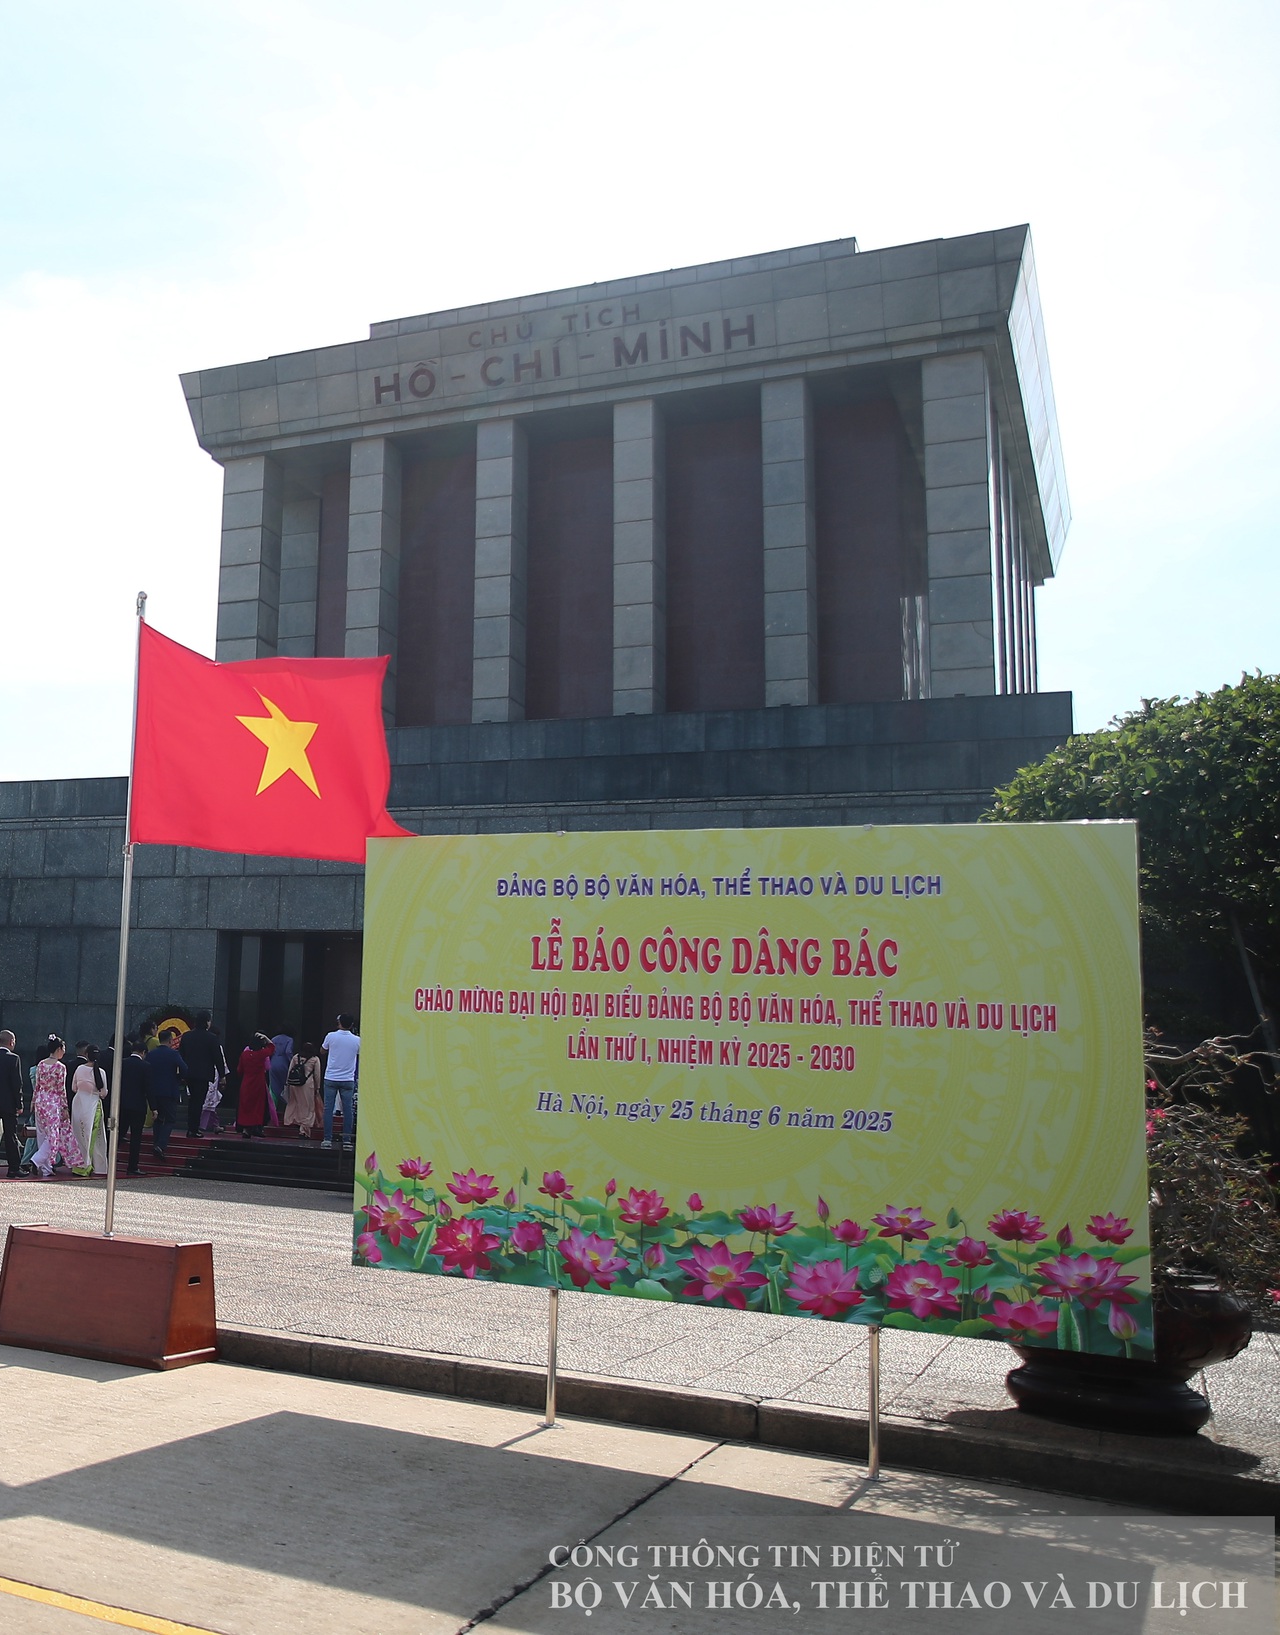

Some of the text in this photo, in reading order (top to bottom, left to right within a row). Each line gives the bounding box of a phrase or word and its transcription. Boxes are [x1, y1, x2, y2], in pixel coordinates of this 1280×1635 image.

[561, 304, 640, 337] TỊCH
[497, 867, 941, 900] ĐẢNG BỘ BỘ VĂN HÓA, THỂ THAO VÀ DU LỊCH
[530, 917, 898, 977] LỄ BÁO CÔNG DÂNG BÁC
[414, 984, 1057, 1037] CHÀO MỪNG ĐẠI HỘI ĐẠI BIỂU ĐẢNG BỘ BỘ VĂN HÓA, THỂ THAO VÀ DU LỊCH
[568, 1027, 599, 1060] LẦN
[604, 1031, 637, 1062] THỨ
[657, 1034, 713, 1069] NHIỆM
[719, 1036, 742, 1066] KỲ
[747, 1043, 791, 1069] 2025
[809, 1045, 856, 1072] 2030
[536, 1091, 894, 1132] Hà Nội, ngày 25 tháng 6 năm 2025
